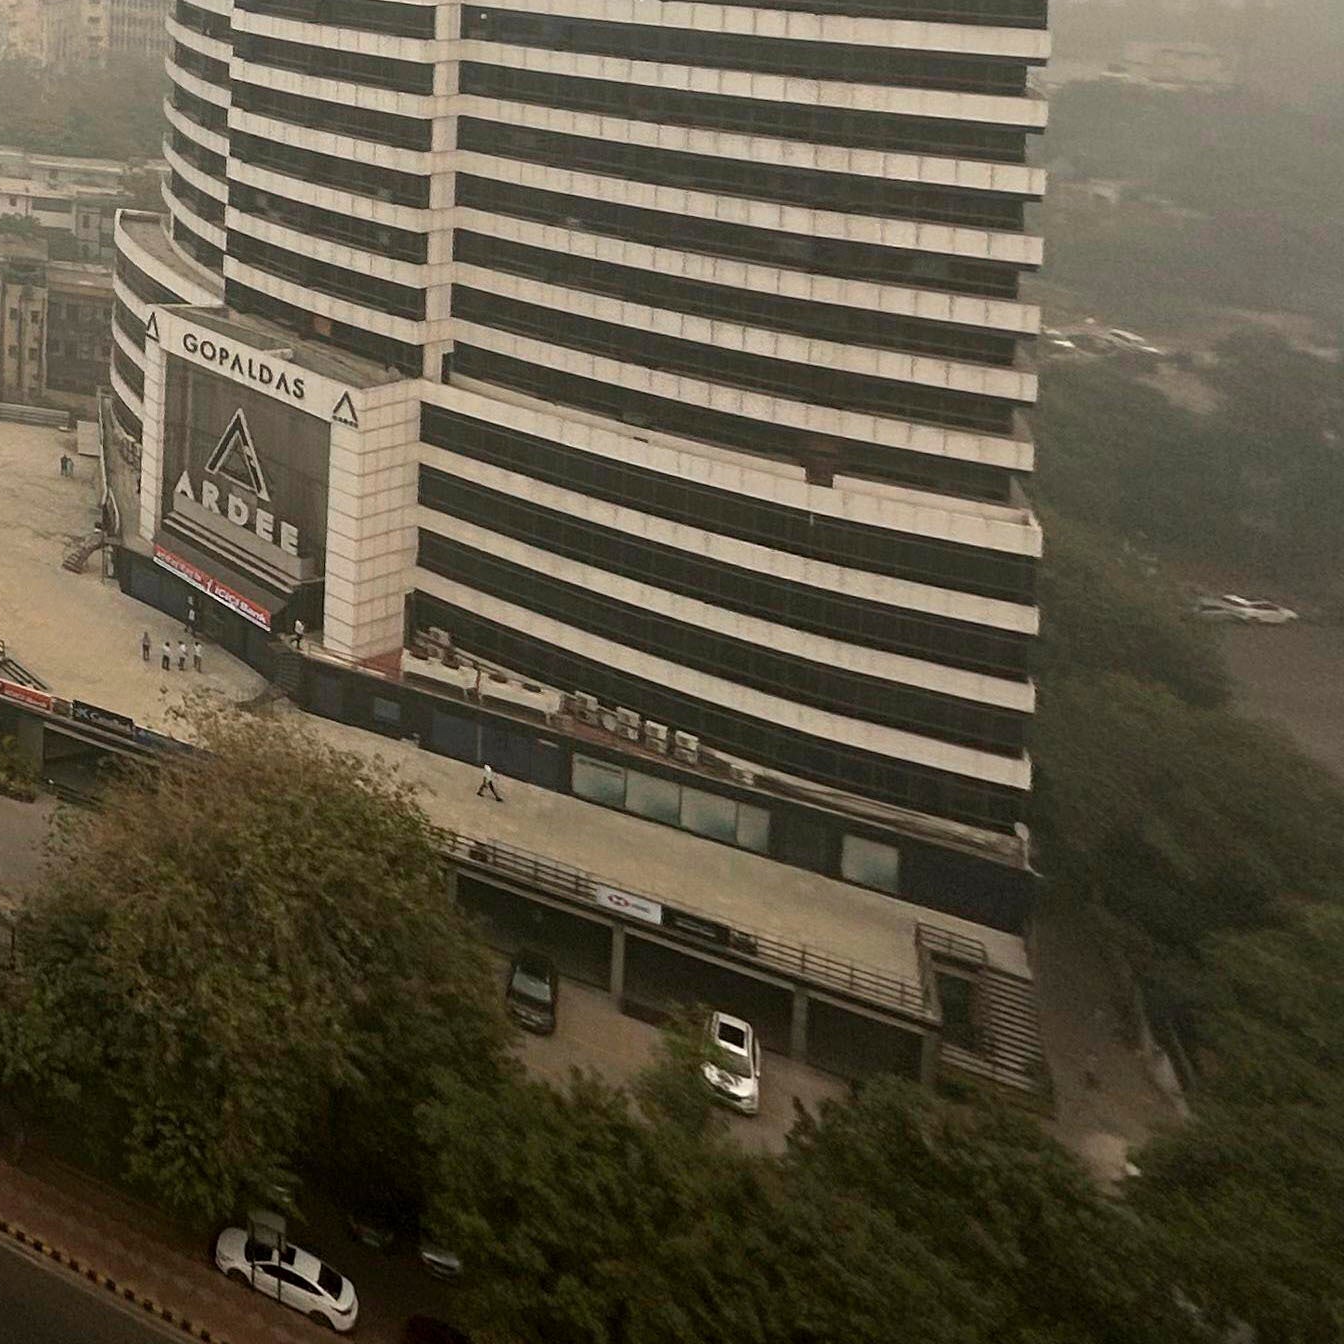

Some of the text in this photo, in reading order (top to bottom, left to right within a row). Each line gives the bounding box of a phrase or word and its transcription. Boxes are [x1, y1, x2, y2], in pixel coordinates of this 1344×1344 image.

[182, 333, 305, 399] GOPALDAS
[174, 470, 299, 556] ARDEE
[239, 601, 268, 625] Bank
